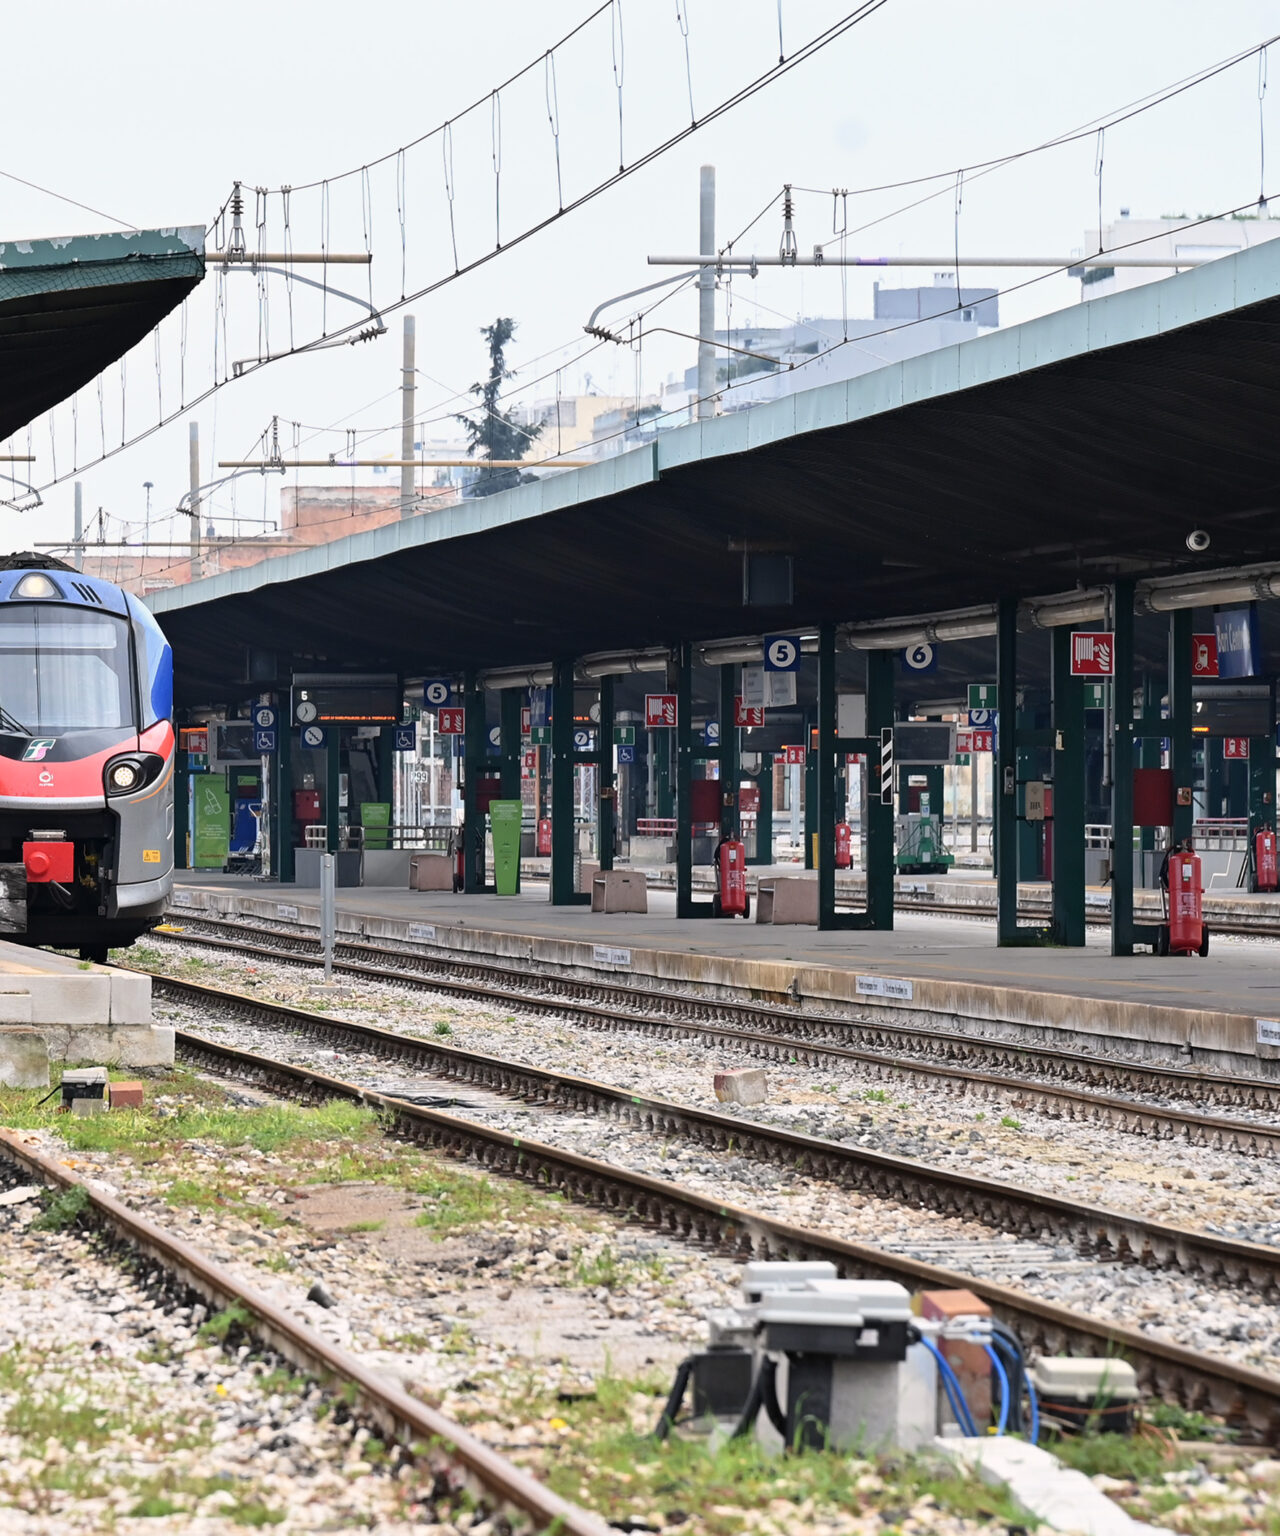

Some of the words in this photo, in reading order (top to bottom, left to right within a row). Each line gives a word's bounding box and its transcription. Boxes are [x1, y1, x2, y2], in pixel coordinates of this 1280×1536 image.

[776, 645, 789, 662] 5
[912, 644, 926, 664] 6
[432, 687, 442, 700] 5
[975, 710, 984, 721] 7
